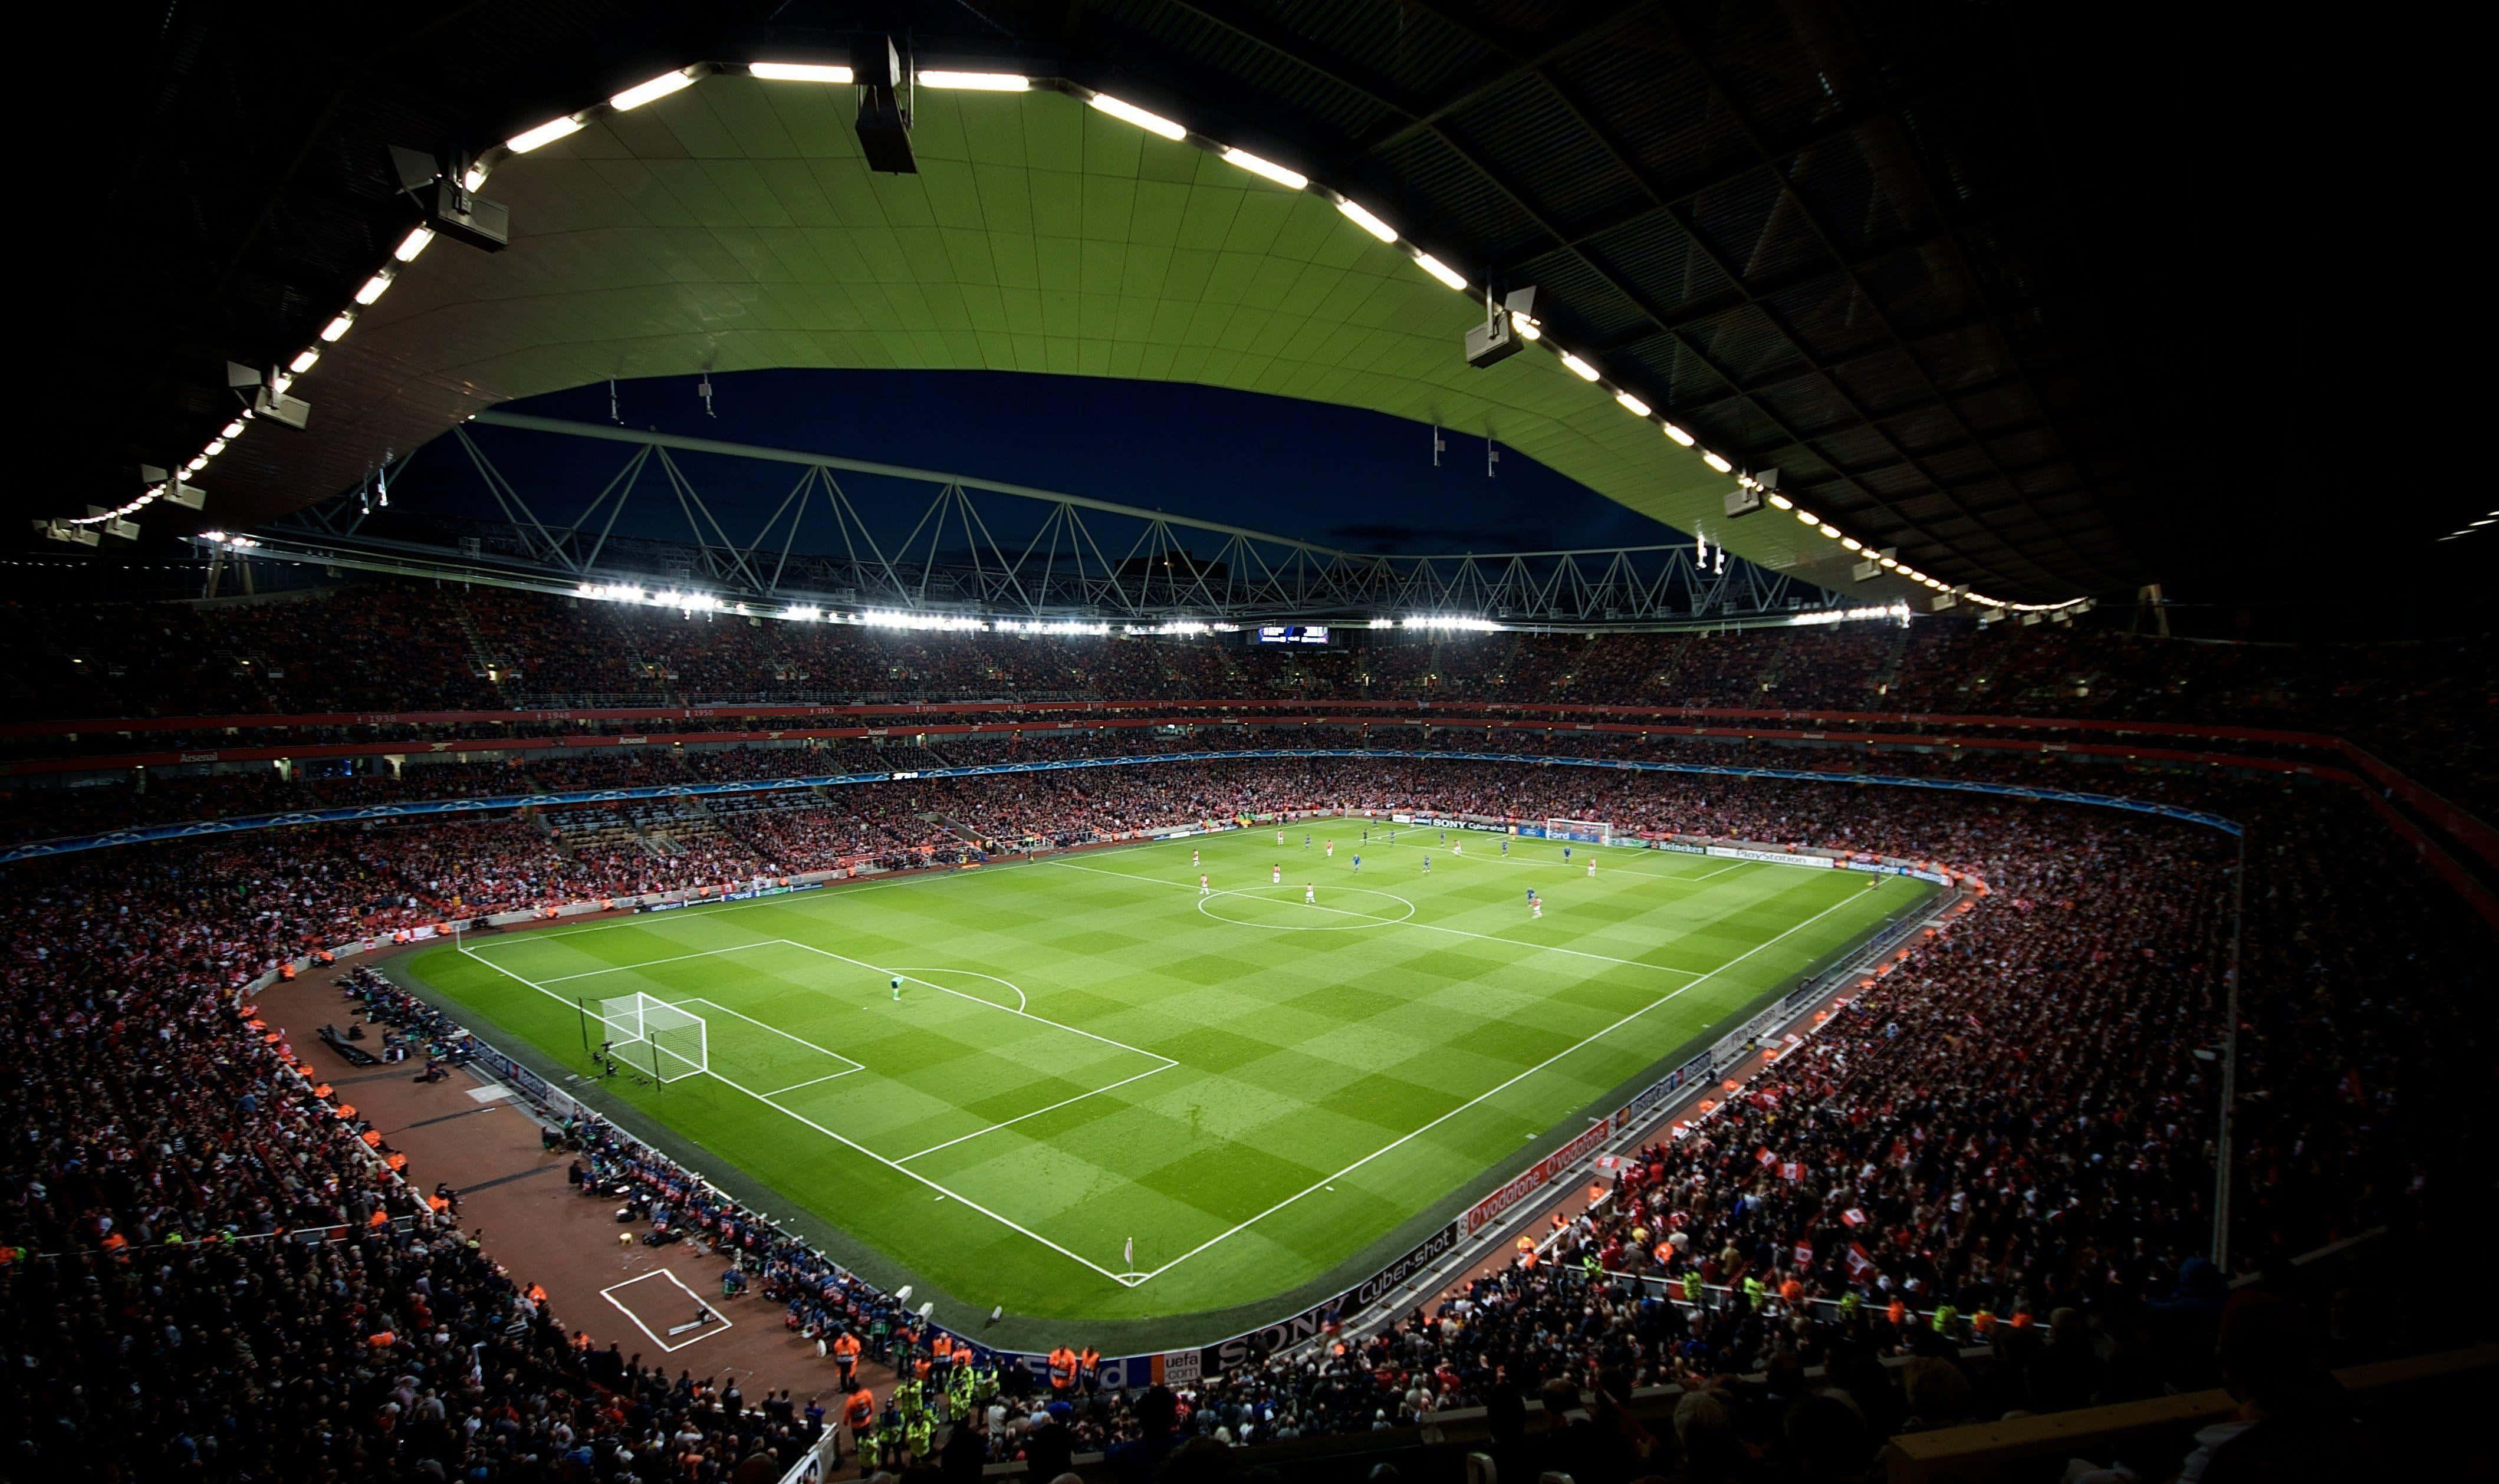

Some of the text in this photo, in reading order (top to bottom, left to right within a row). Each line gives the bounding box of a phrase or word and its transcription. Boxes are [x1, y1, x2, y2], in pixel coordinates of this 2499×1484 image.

[619, 736, 647, 745] Arsenal
[181, 752, 218, 762] Arsenal
[1433, 818, 1468, 829] SONY
[1468, 822, 1507, 833] Cyber-shot
[1548, 831, 1570, 840] Ford
[1659, 841, 1704, 854] Heineken
[1736, 849, 1807, 864] PlayStation
[1557, 1127, 1605, 1168] vodafone
[1481, 1170, 1540, 1219] vodafone
[1359, 1229, 1450, 1305] Cyber-shot
[1166, 1353, 1198, 1368] uefa
[1023, 1355, 1127, 1391] Fd
